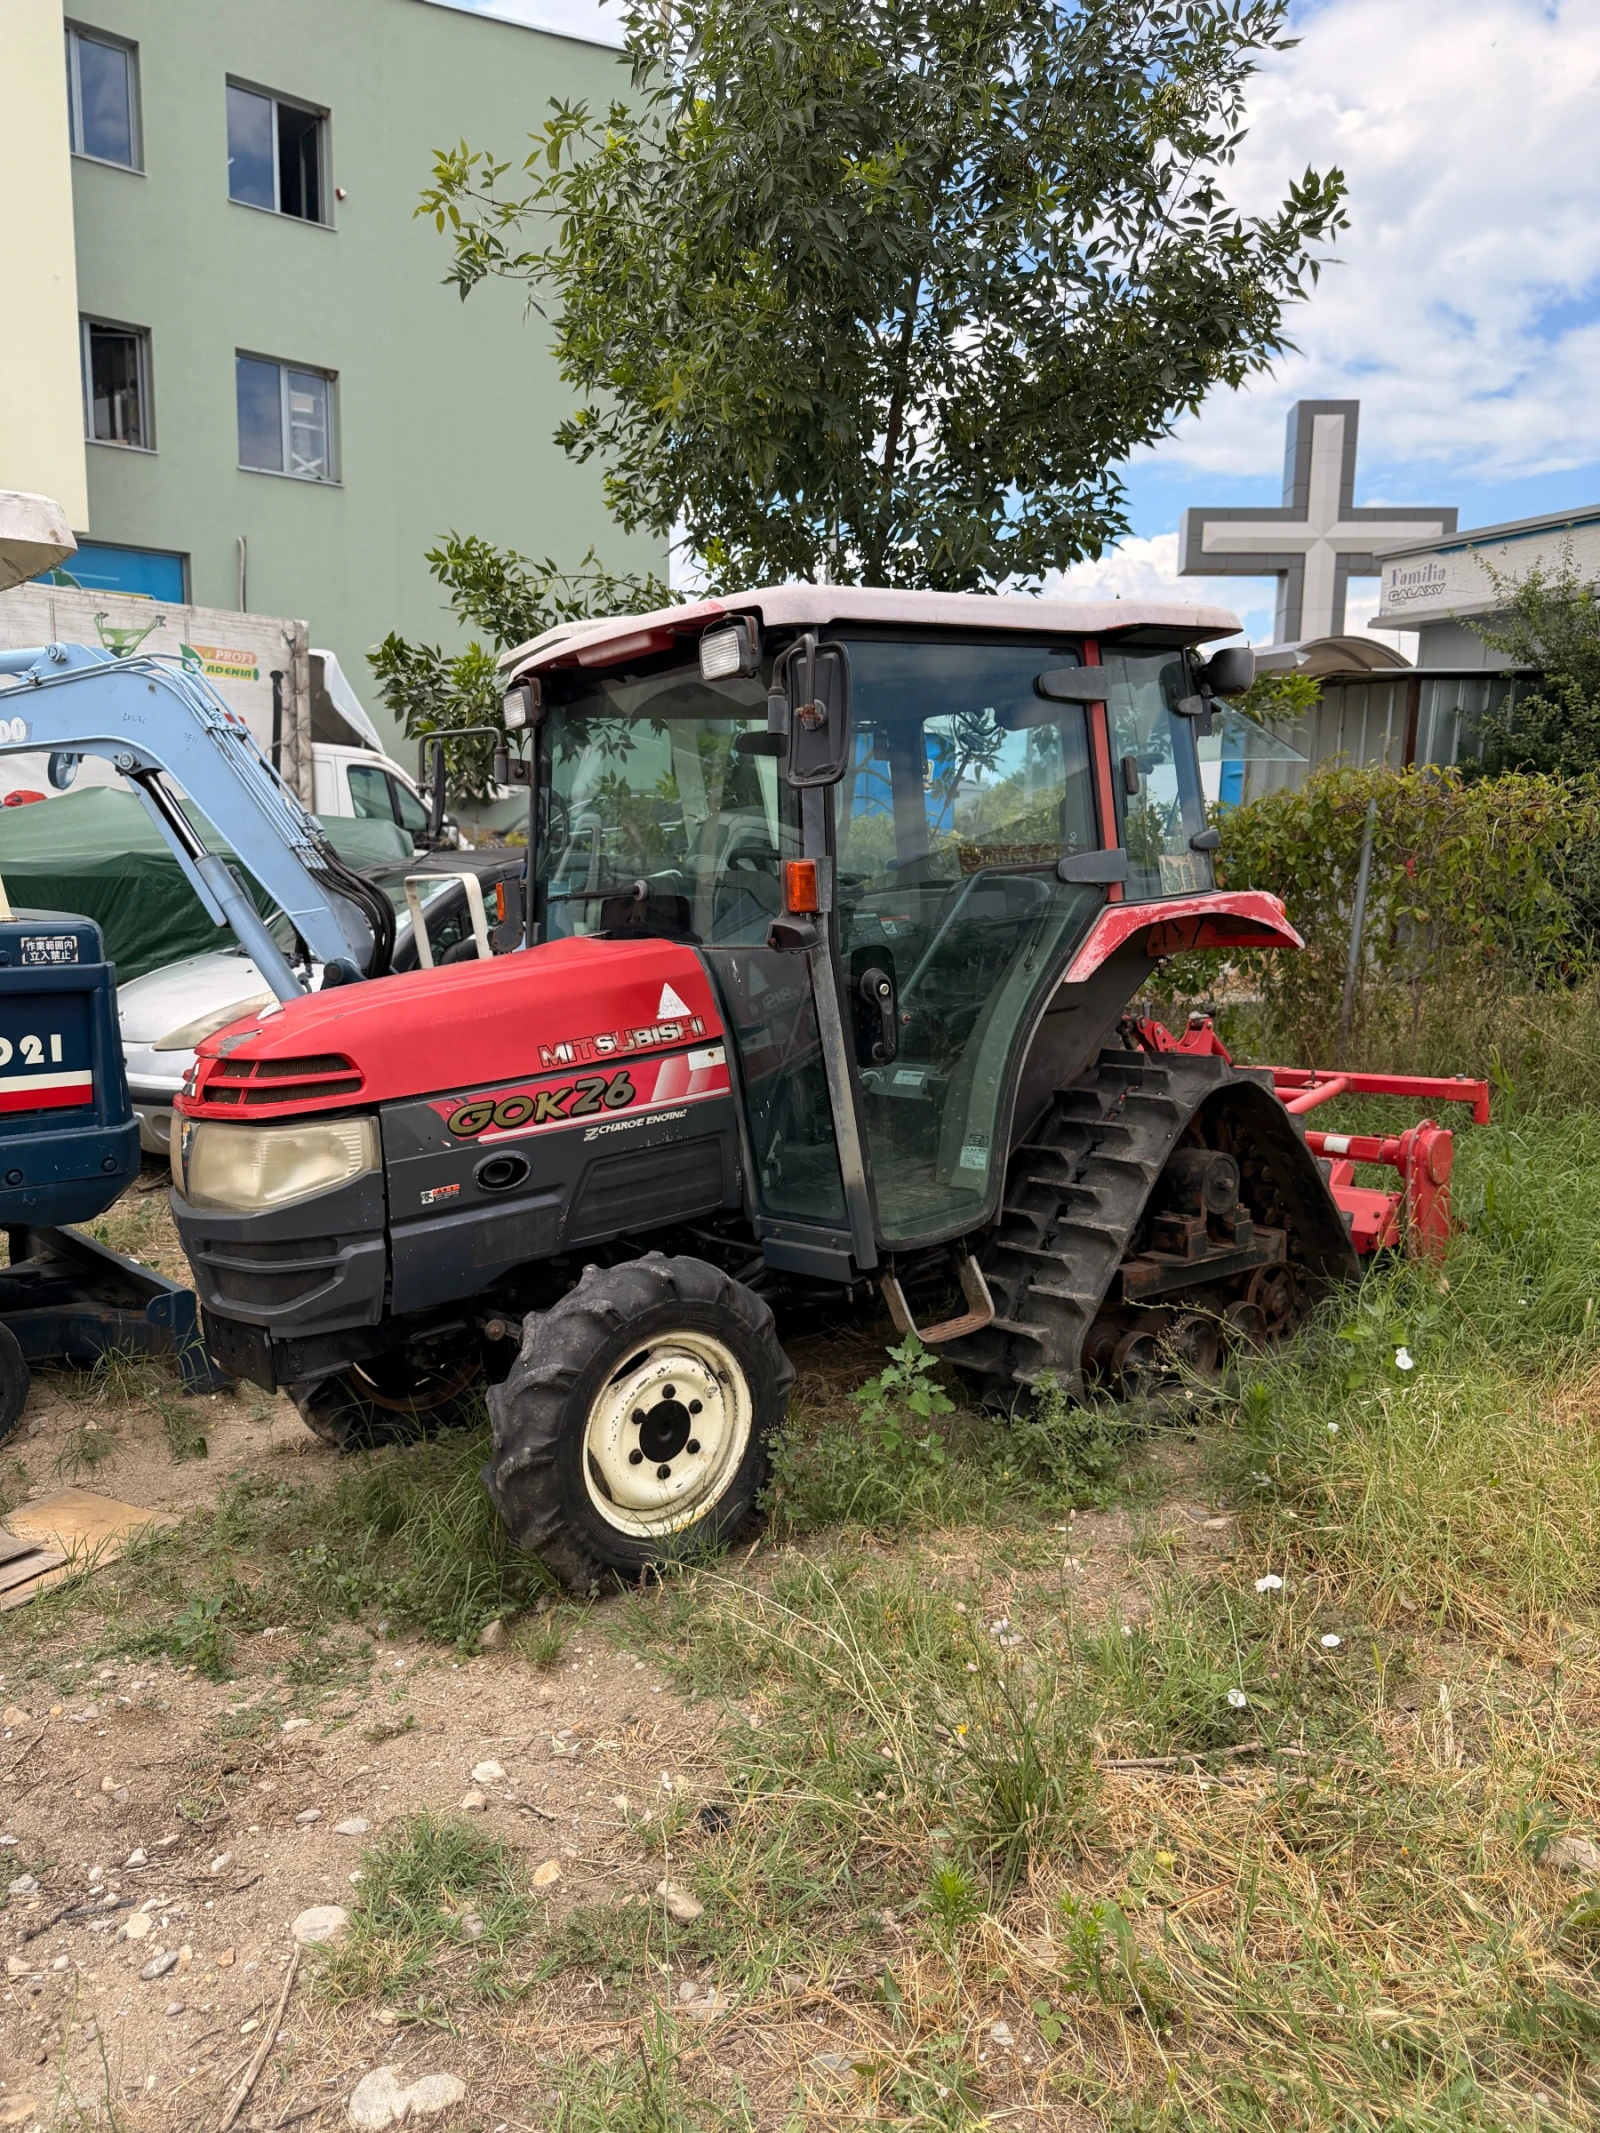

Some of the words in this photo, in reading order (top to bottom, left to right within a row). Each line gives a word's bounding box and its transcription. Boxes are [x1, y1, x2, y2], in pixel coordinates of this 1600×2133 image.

[1392, 563, 1446, 587] Familia
[1388, 583, 1446, 602] GALAXY
[215, 649, 254, 665] PROFI
[26, 940, 73, 951] 作業範囲内
[29, 950, 71, 961] 立入禁止
[537, 1016, 707, 1068] MITSUBISHI
